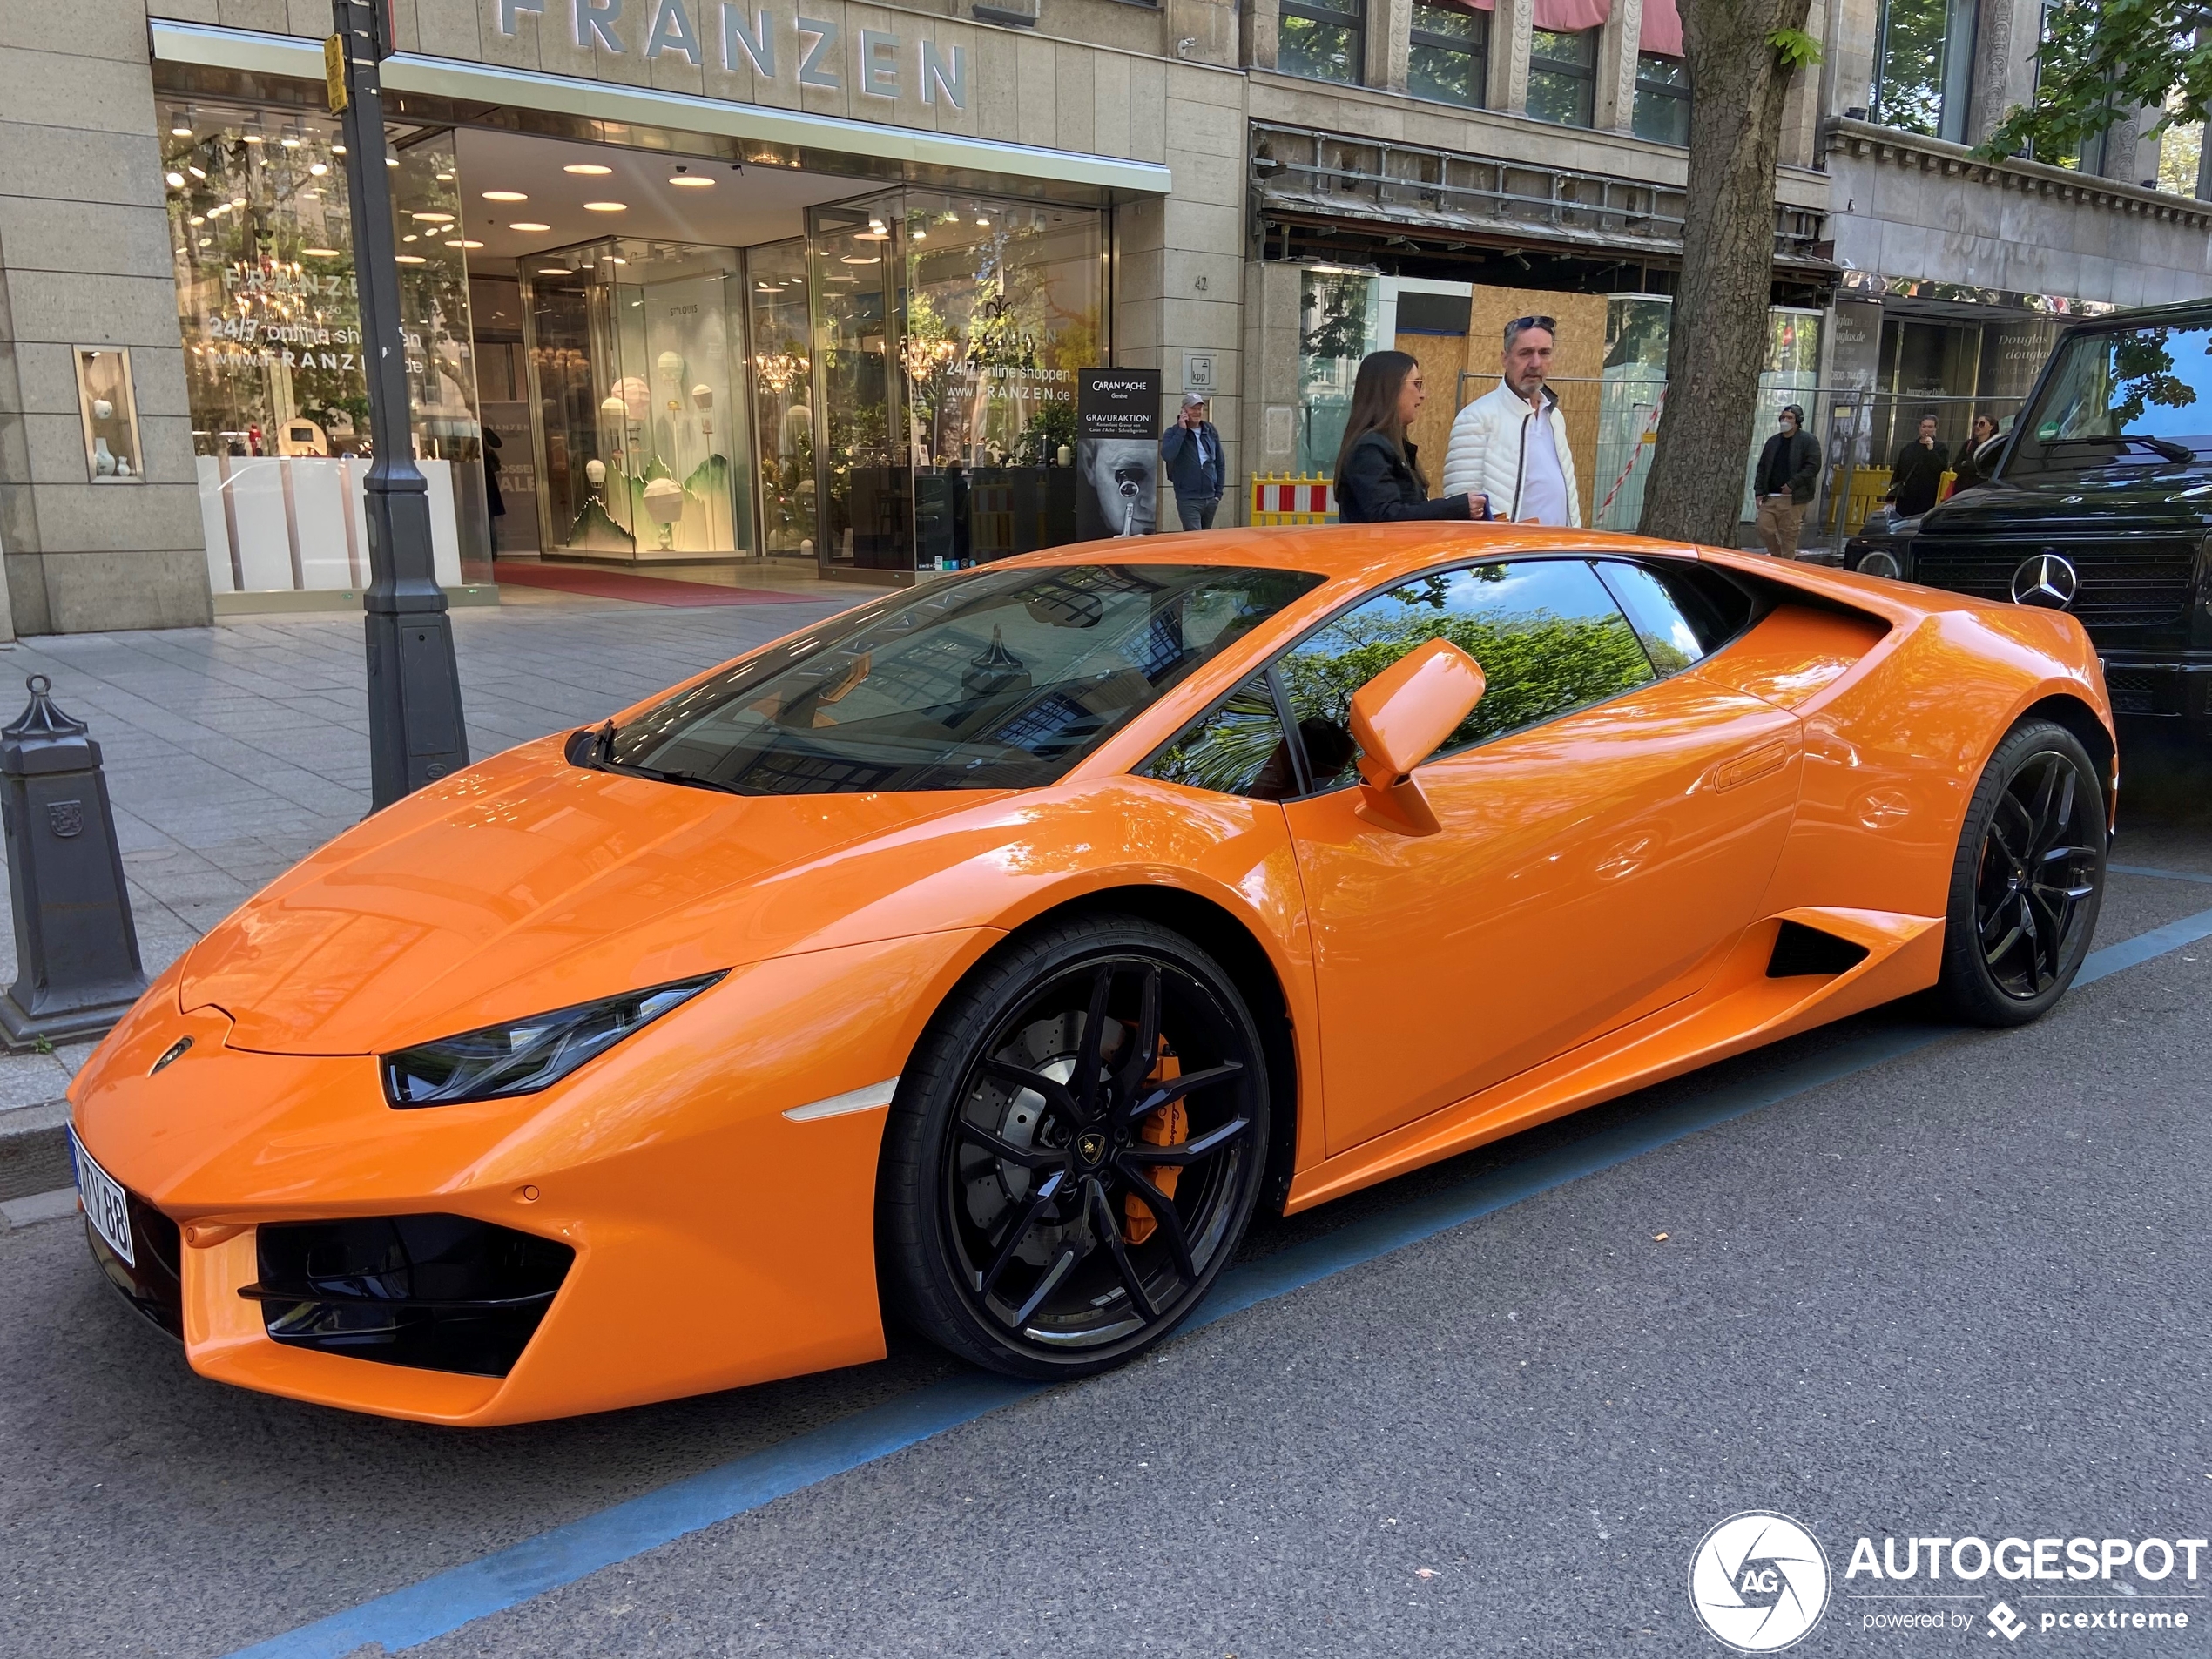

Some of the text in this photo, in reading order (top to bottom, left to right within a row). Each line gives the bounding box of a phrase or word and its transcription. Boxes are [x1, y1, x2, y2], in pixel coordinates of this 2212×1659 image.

[1195, 276, 1208, 290] 42
[208, 316, 259, 341] 24/7
[1998, 334, 2047, 347] Douglas
[946, 361, 1070, 383] 24/7 online shoppen
[1085, 414, 1152, 422] GRAVURAKTION!
[103, 1184, 128, 1251] 88
